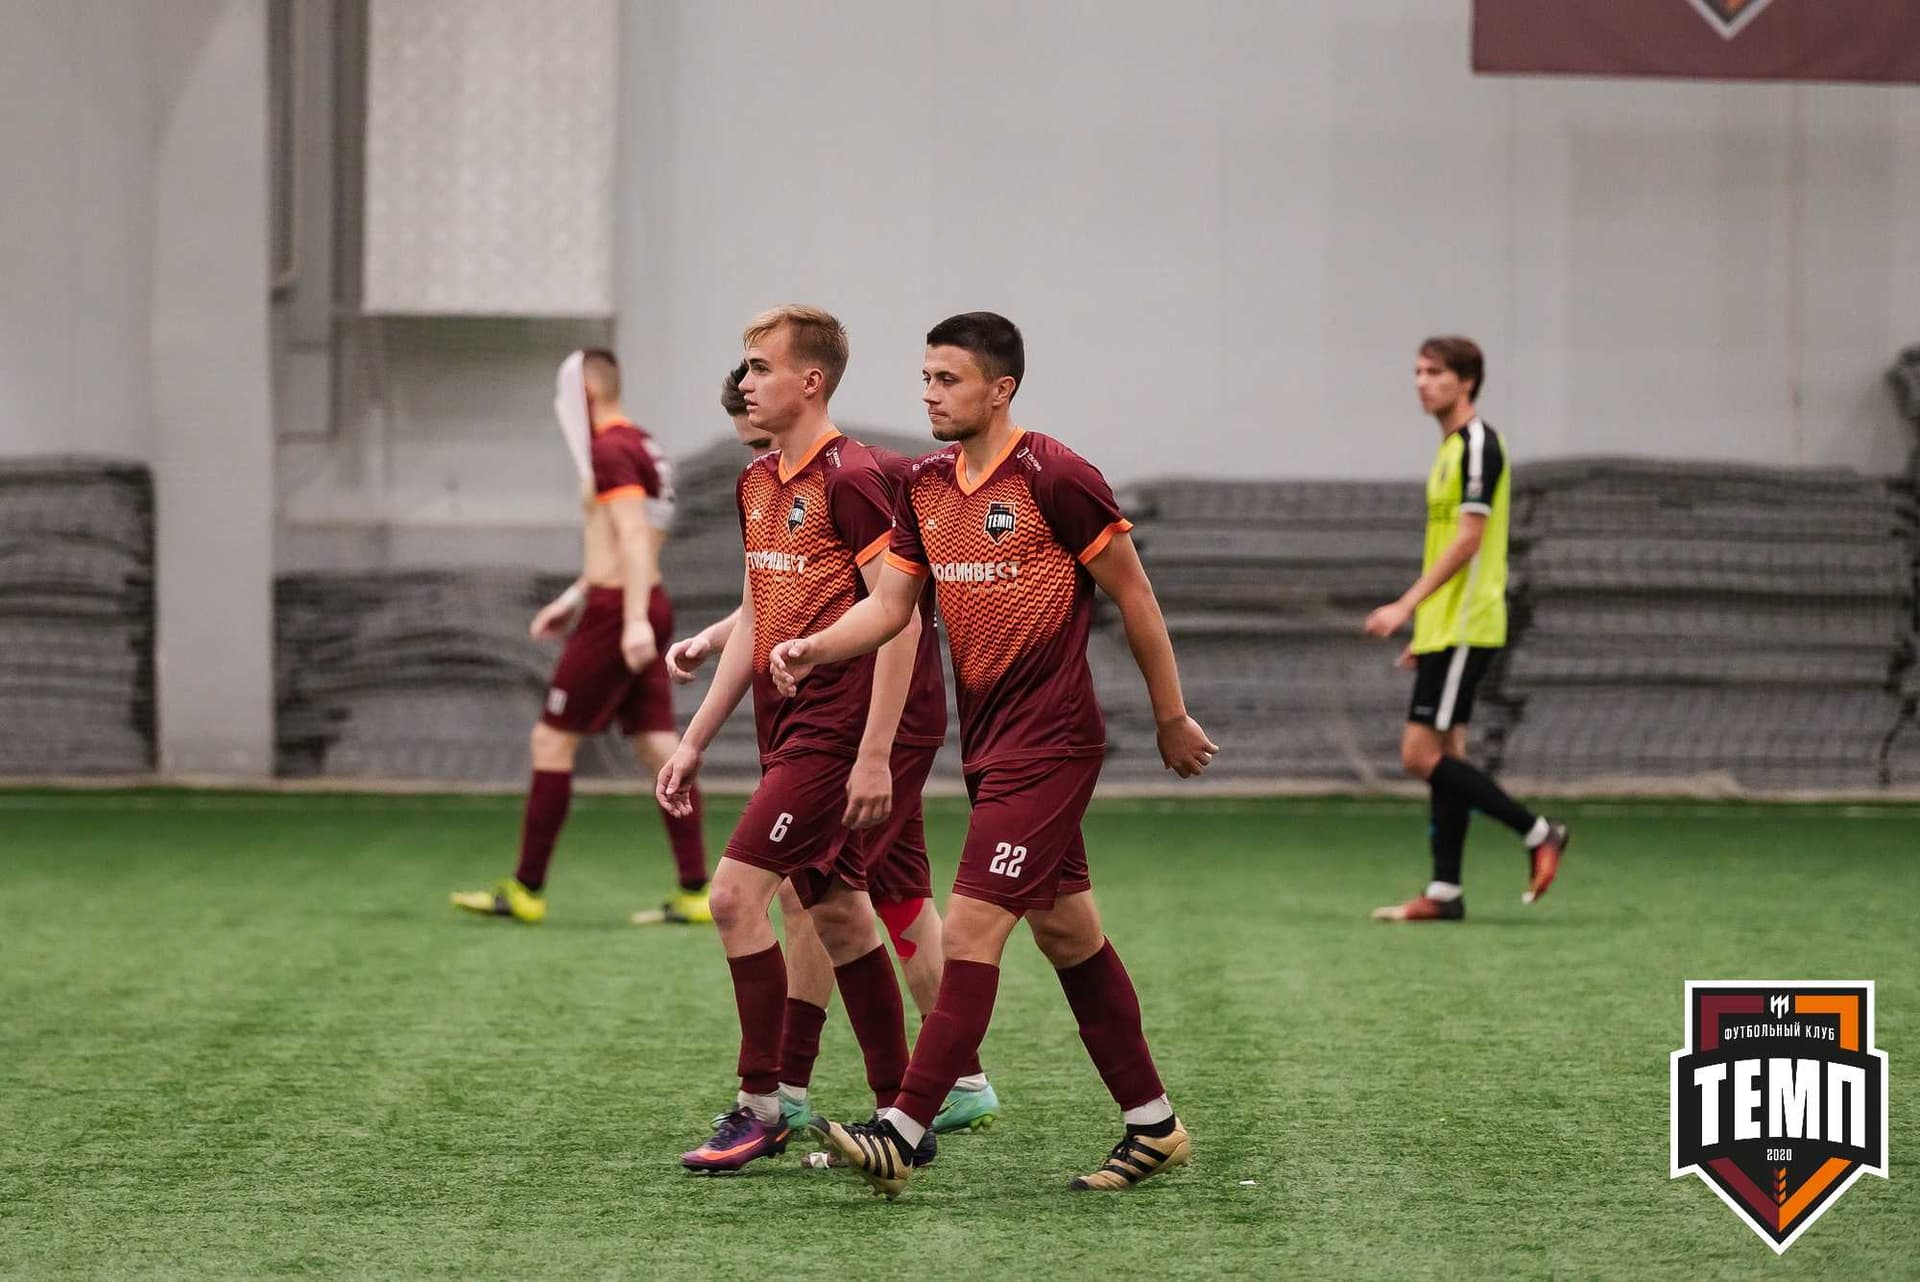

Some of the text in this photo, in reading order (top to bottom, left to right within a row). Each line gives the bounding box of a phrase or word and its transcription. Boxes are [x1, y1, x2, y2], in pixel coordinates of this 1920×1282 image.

[988, 514, 1013, 529] ТЕМП
[769, 812, 793, 842] 6
[989, 842, 1027, 878] 22
